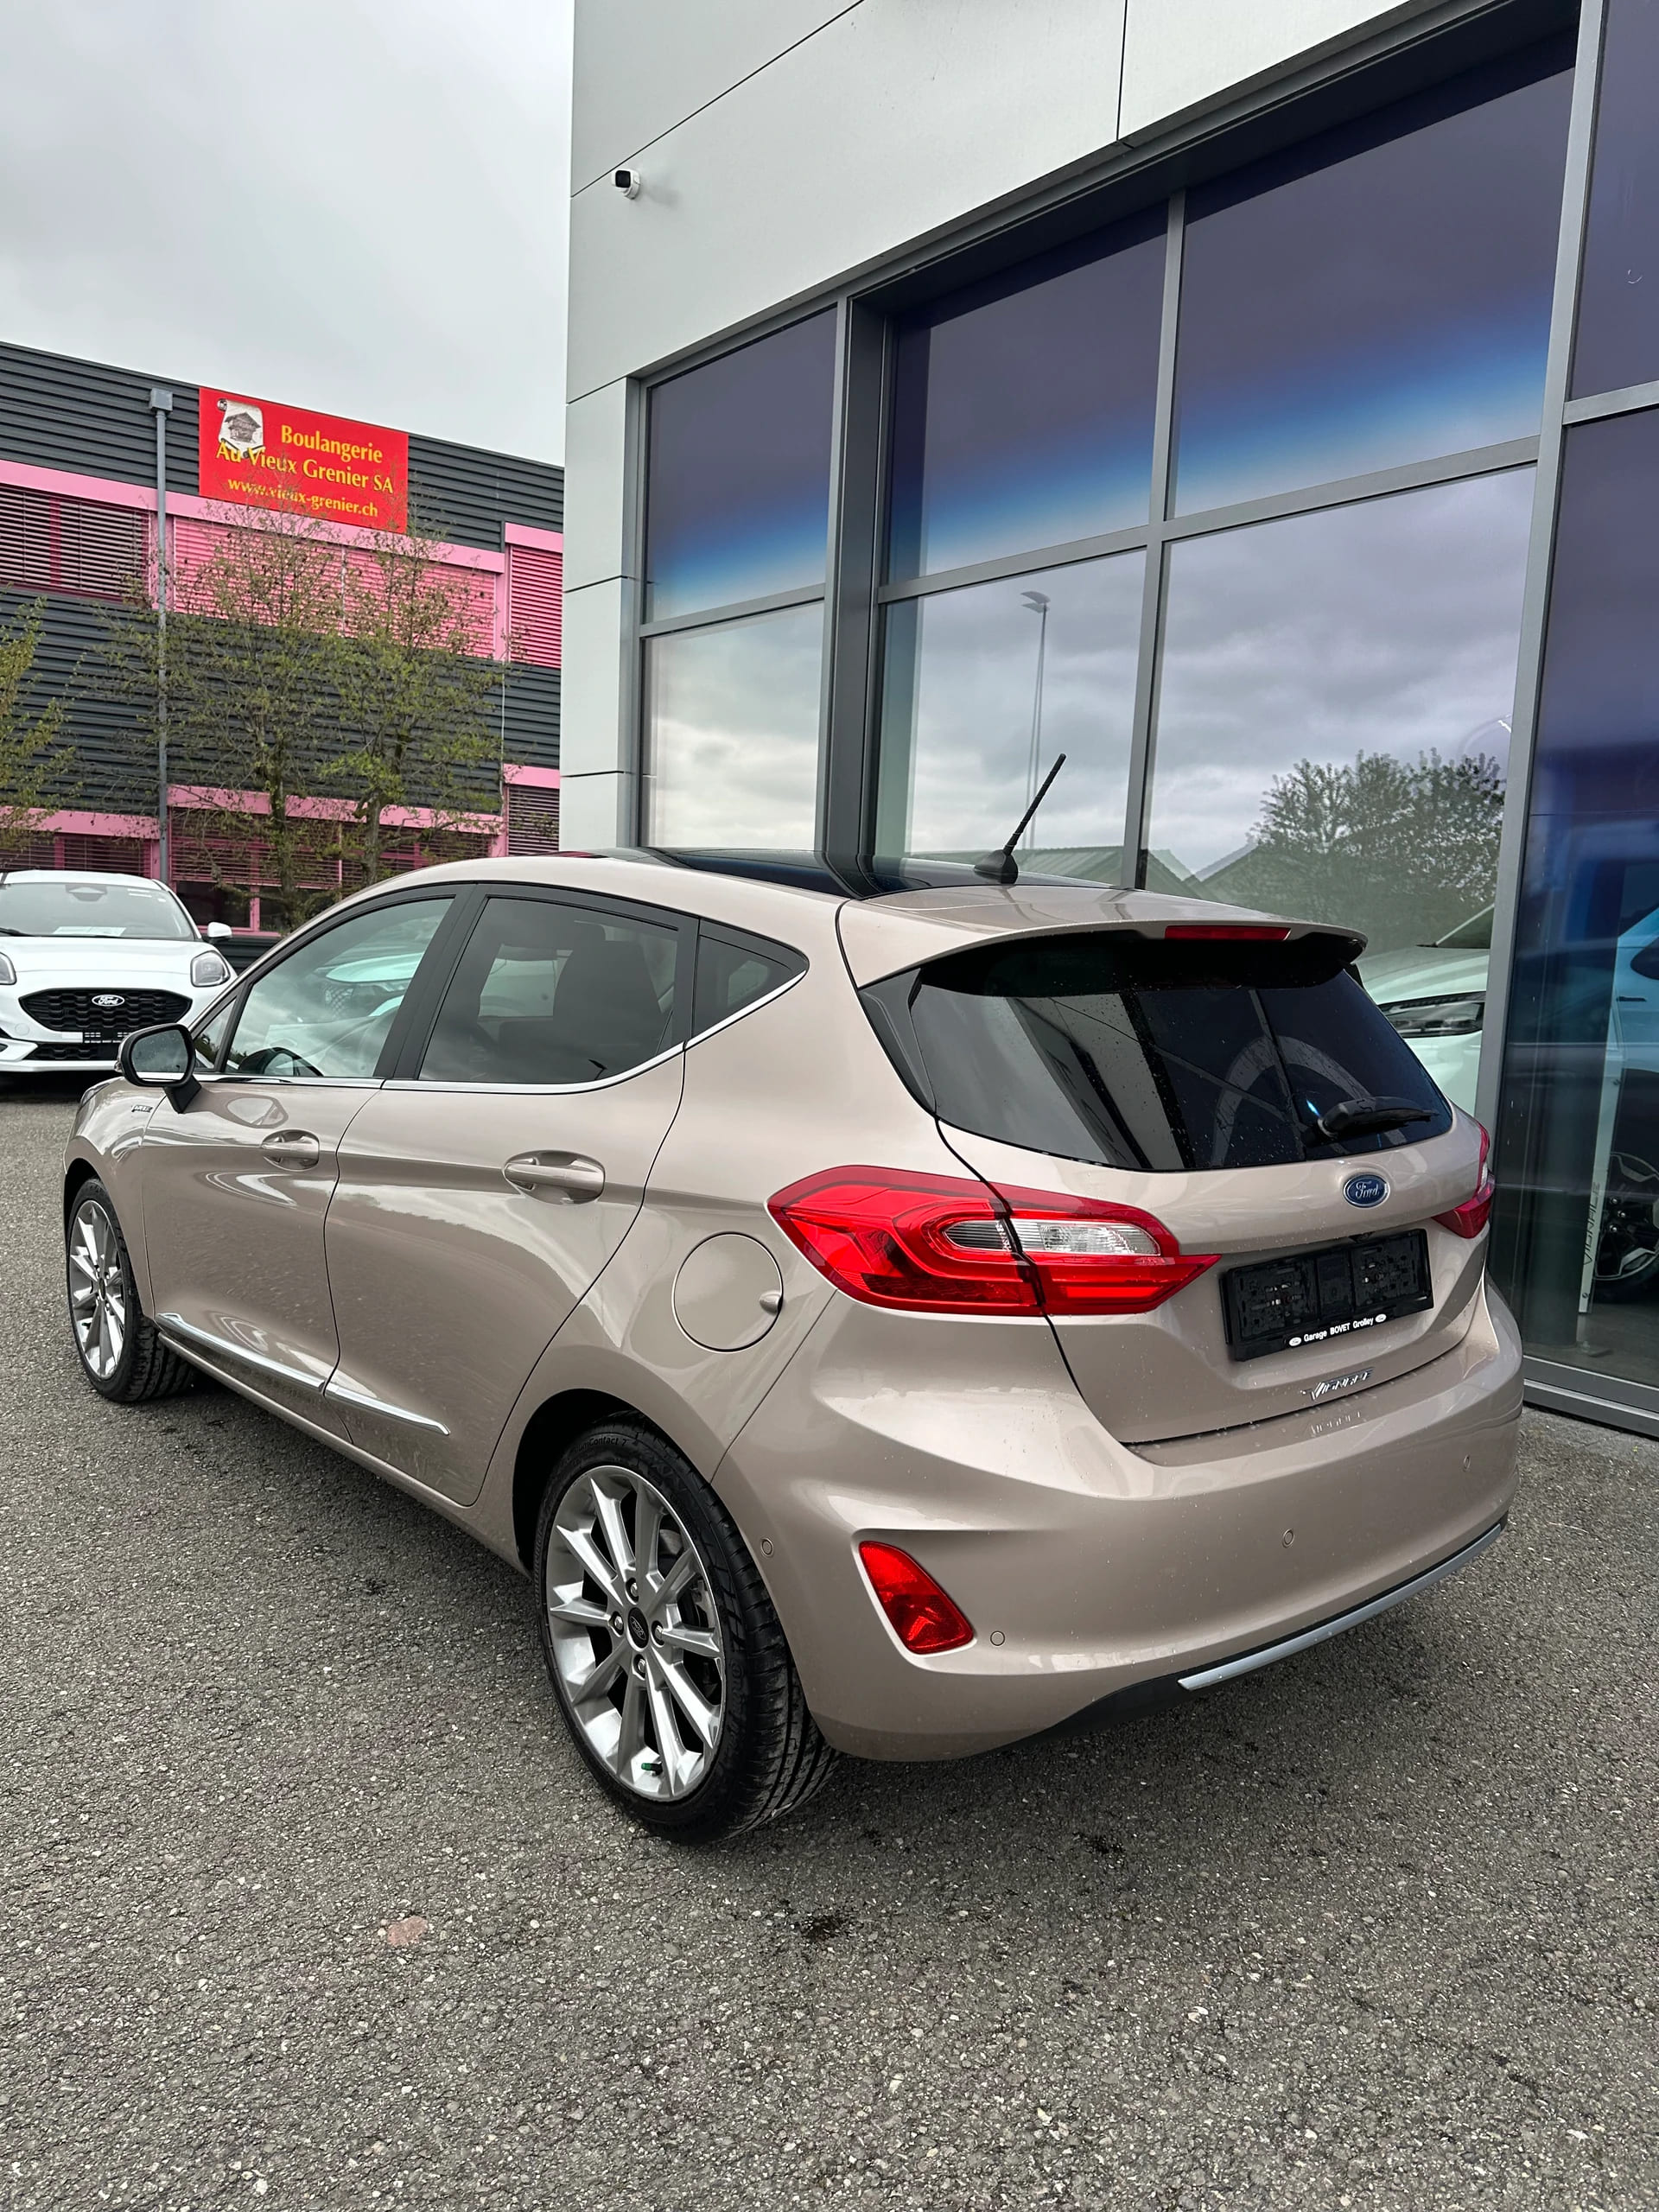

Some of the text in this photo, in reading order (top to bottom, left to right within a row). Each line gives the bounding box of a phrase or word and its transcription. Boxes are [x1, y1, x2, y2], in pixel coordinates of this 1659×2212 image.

[281, 424, 383, 463] Boulangerie
[216, 441, 393, 494] Au Vieux Grenier SA
[227, 478, 378, 518] www.vieux-grenier.ch
[1303, 1330, 1328, 1343] Garage
[1330, 1322, 1351, 1335] BOVET
